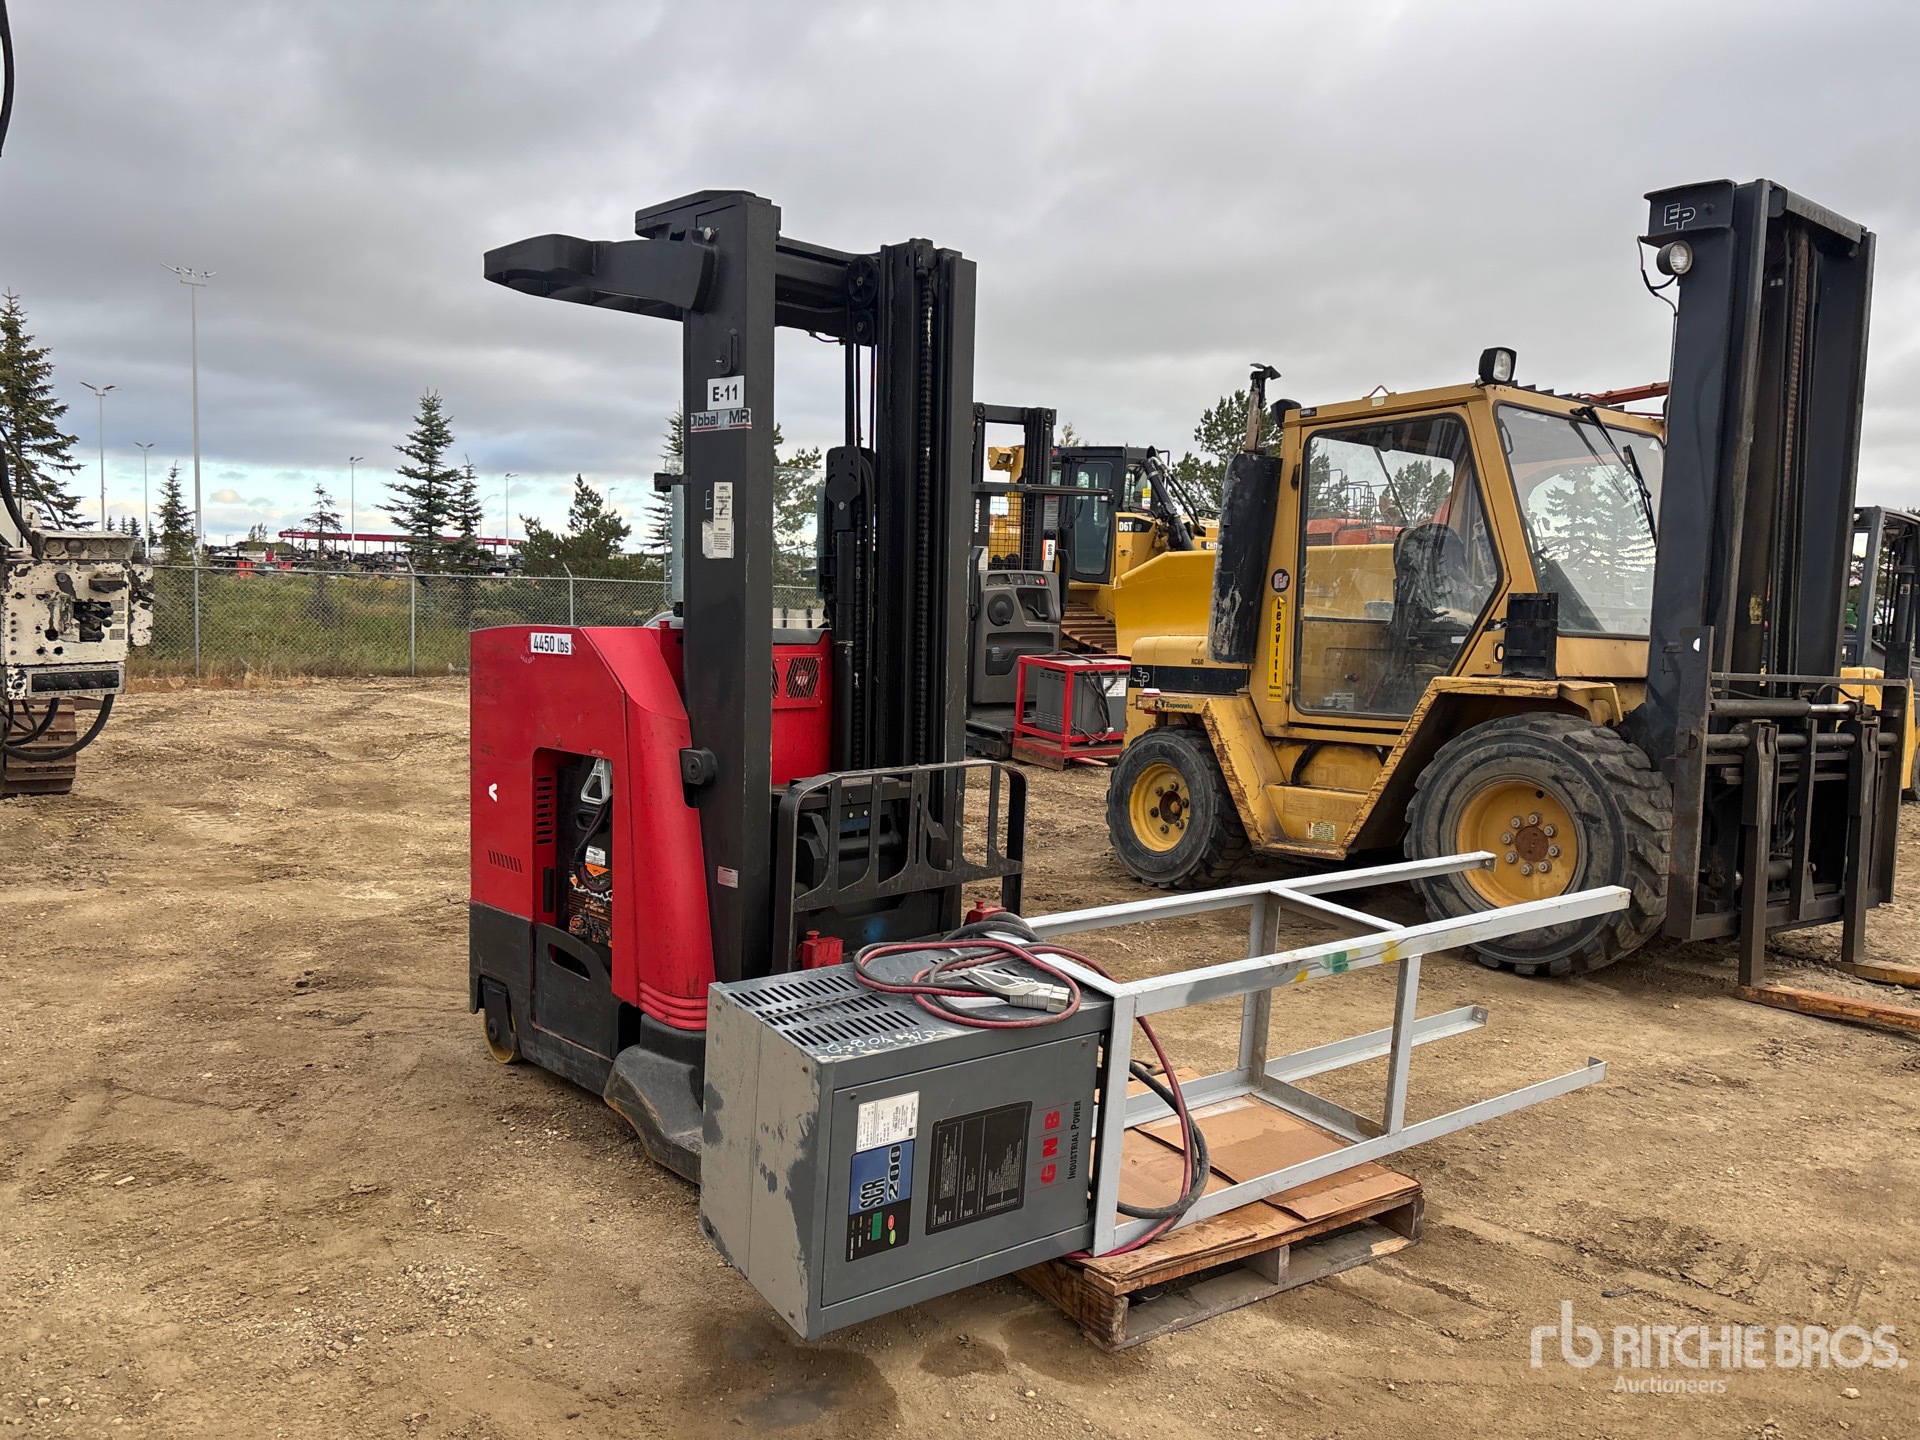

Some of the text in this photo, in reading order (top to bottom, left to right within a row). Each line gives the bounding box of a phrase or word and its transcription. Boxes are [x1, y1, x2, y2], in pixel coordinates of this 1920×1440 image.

[1664, 203, 1696, 230] EP
[712, 384, 738, 402] E-11
[1118, 521, 1133, 532] D6T
[533, 635, 569, 653] 4450 lbs
[1274, 598, 1282, 683] Leavitt
[1191, 658, 1204, 666] RC60
[1041, 1110, 1060, 1183] GNB
[1067, 1100, 1081, 1180] INDUSTRIAL POWER
[888, 1144, 902, 1200] 200
[859, 1177, 886, 1209] SCR
